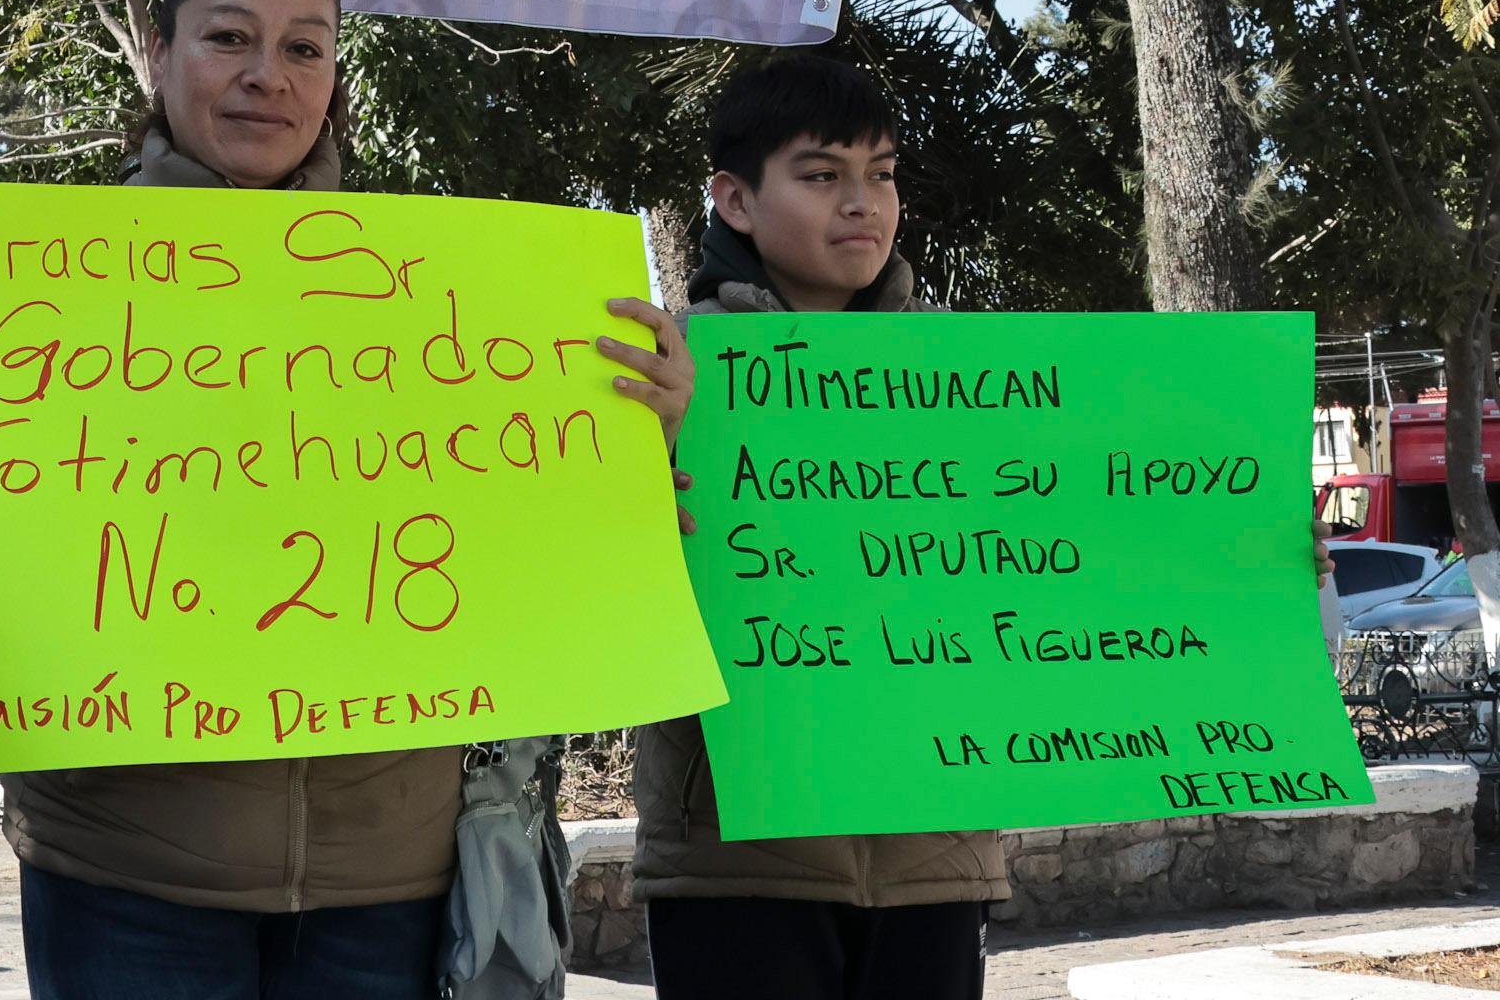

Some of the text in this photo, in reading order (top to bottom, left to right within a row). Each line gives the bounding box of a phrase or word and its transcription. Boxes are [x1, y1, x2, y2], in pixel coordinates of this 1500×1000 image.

[718, 342, 1060, 410] TOTIMEHUACAN
[732, 445, 1259, 500] AGRADECE SU APOYO
[95, 513, 459, 631] No. 218
[860, 530, 1079, 577] DIPUTADO
[734, 616, 851, 667] JOSE
[993, 611, 1207, 661] FIGUEROA
[269, 686, 496, 743] DEFENSA
[934, 734, 990, 765] LA
[1007, 725, 1169, 763] COMISION
[1160, 772, 1349, 809] DEFENSA
